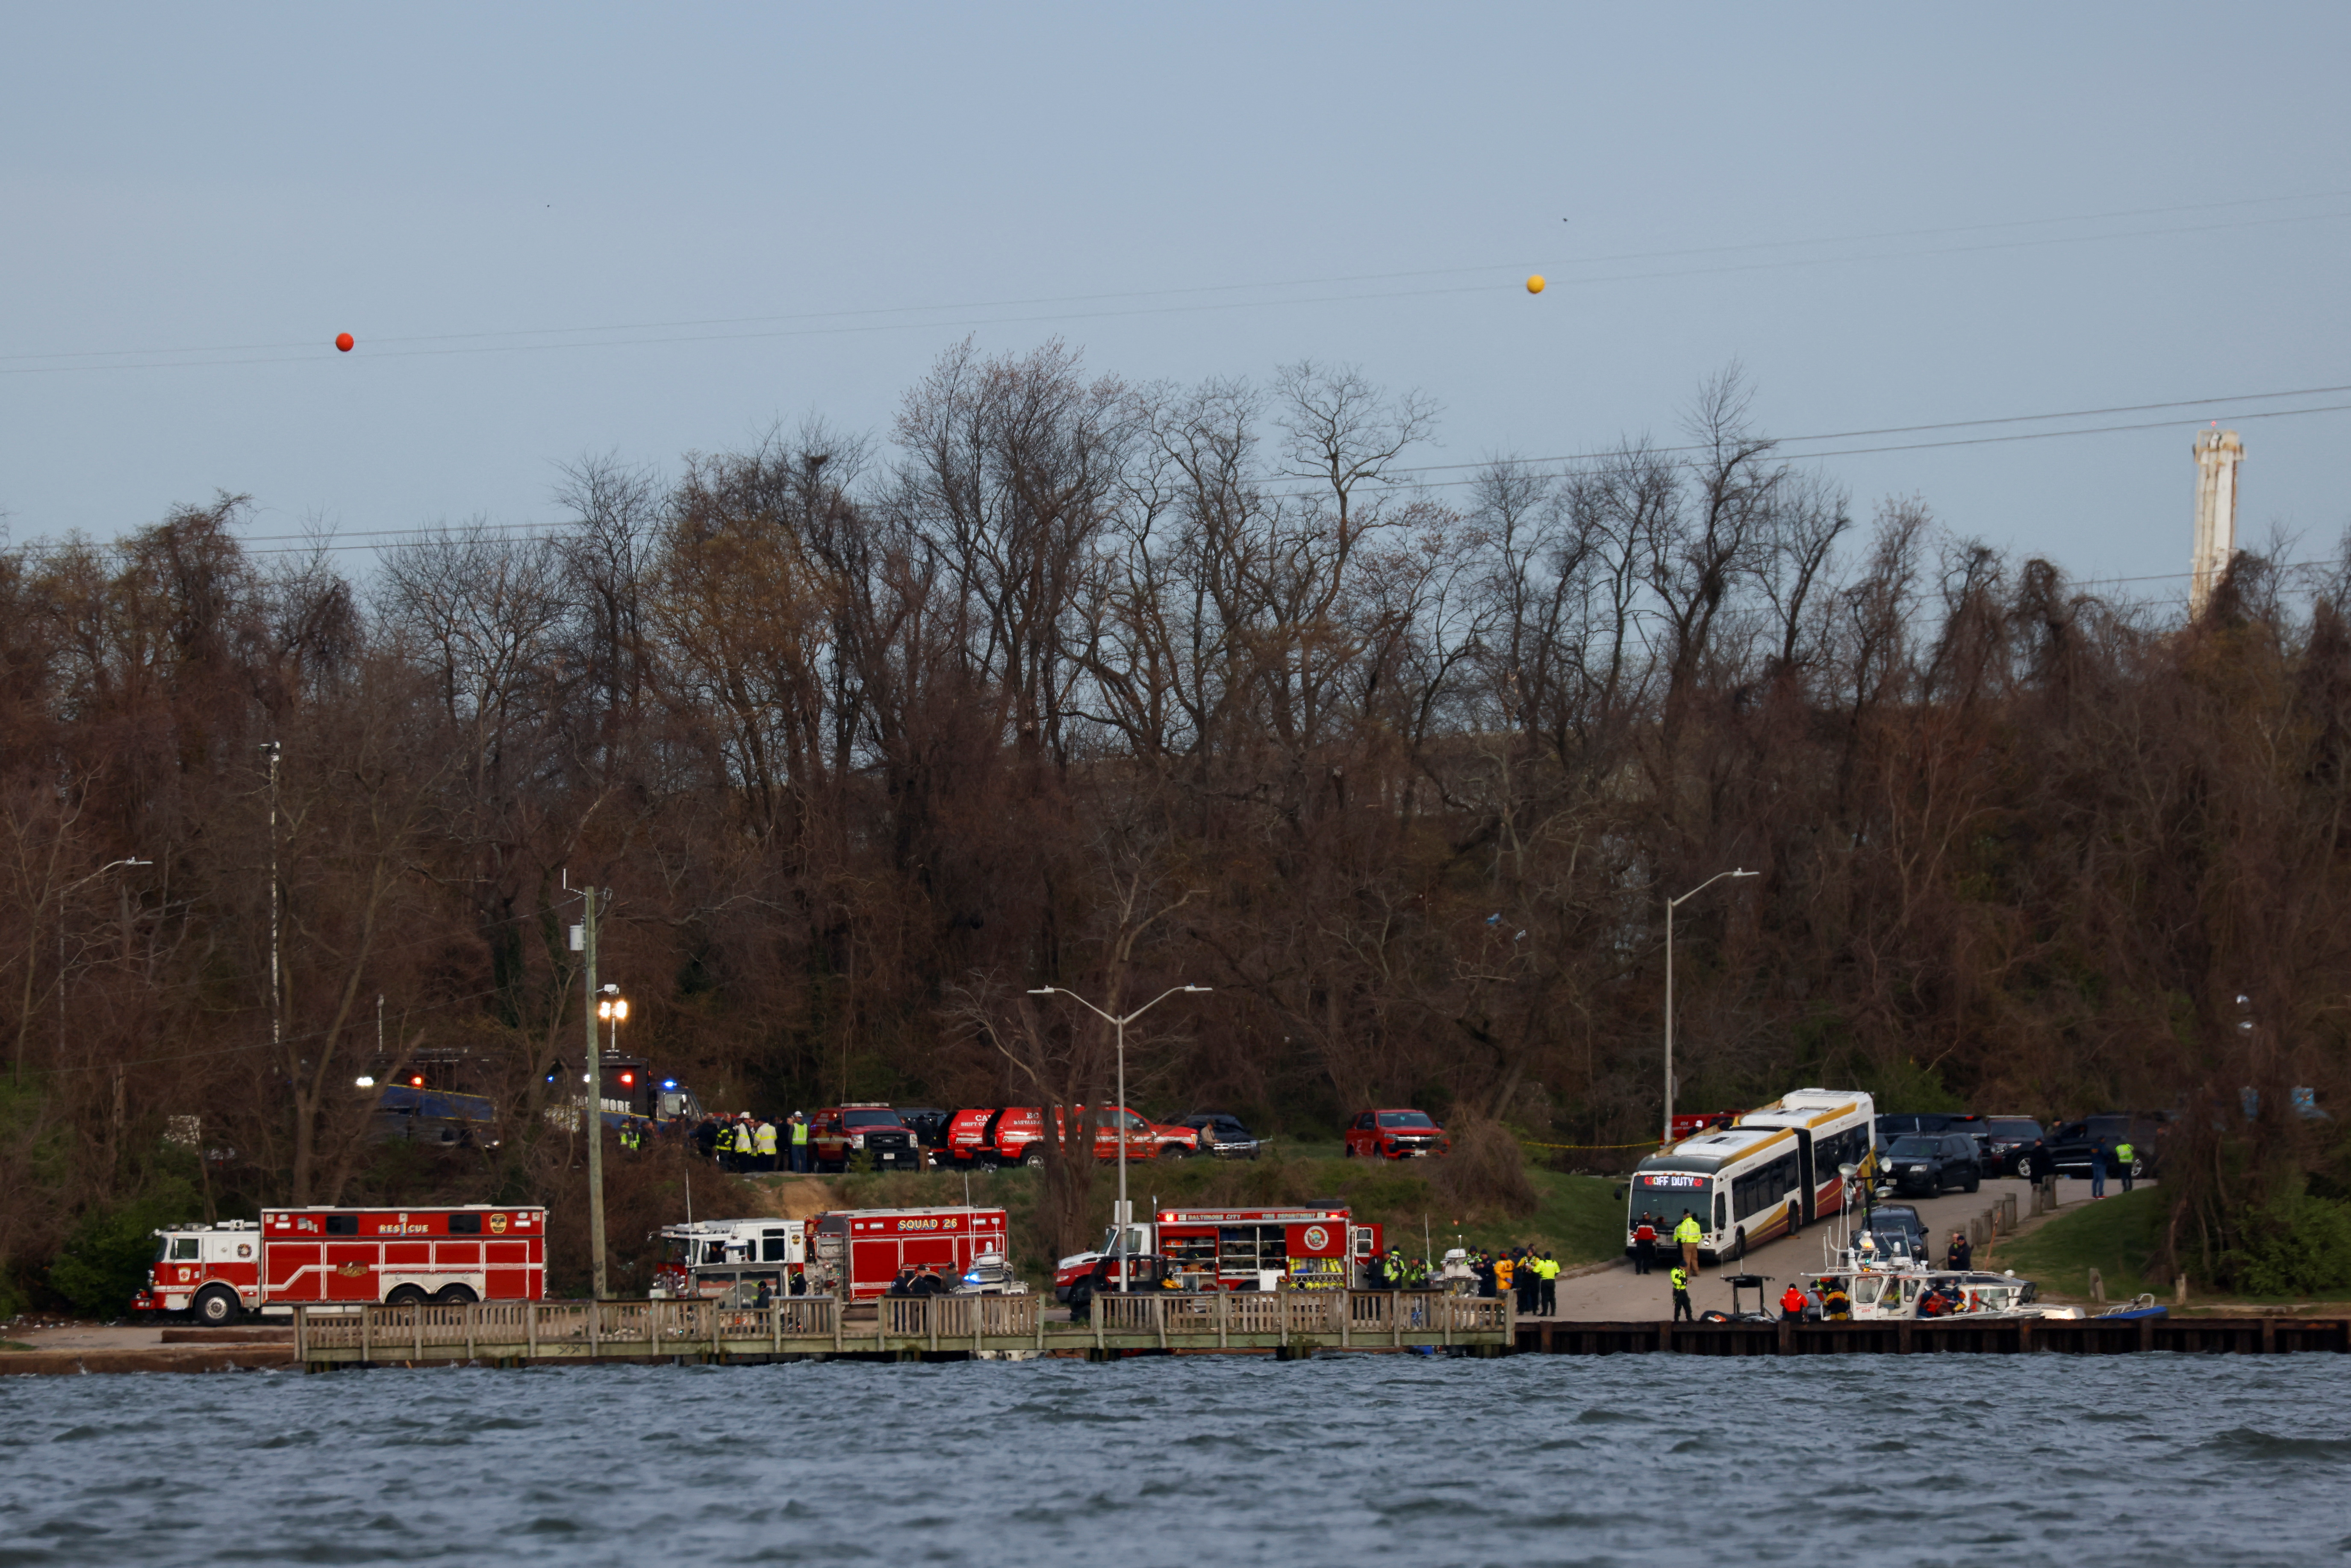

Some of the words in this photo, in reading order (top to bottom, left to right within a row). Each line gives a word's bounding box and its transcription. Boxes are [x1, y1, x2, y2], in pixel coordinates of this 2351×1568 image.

[572, 1095, 631, 1113] ALMORE
[1653, 1176, 1669, 1186] OFF
[1671, 1176, 1694, 1186] DUTY
[898, 1219, 938, 1231] SQUAD
[943, 1218, 957, 1229] 26
